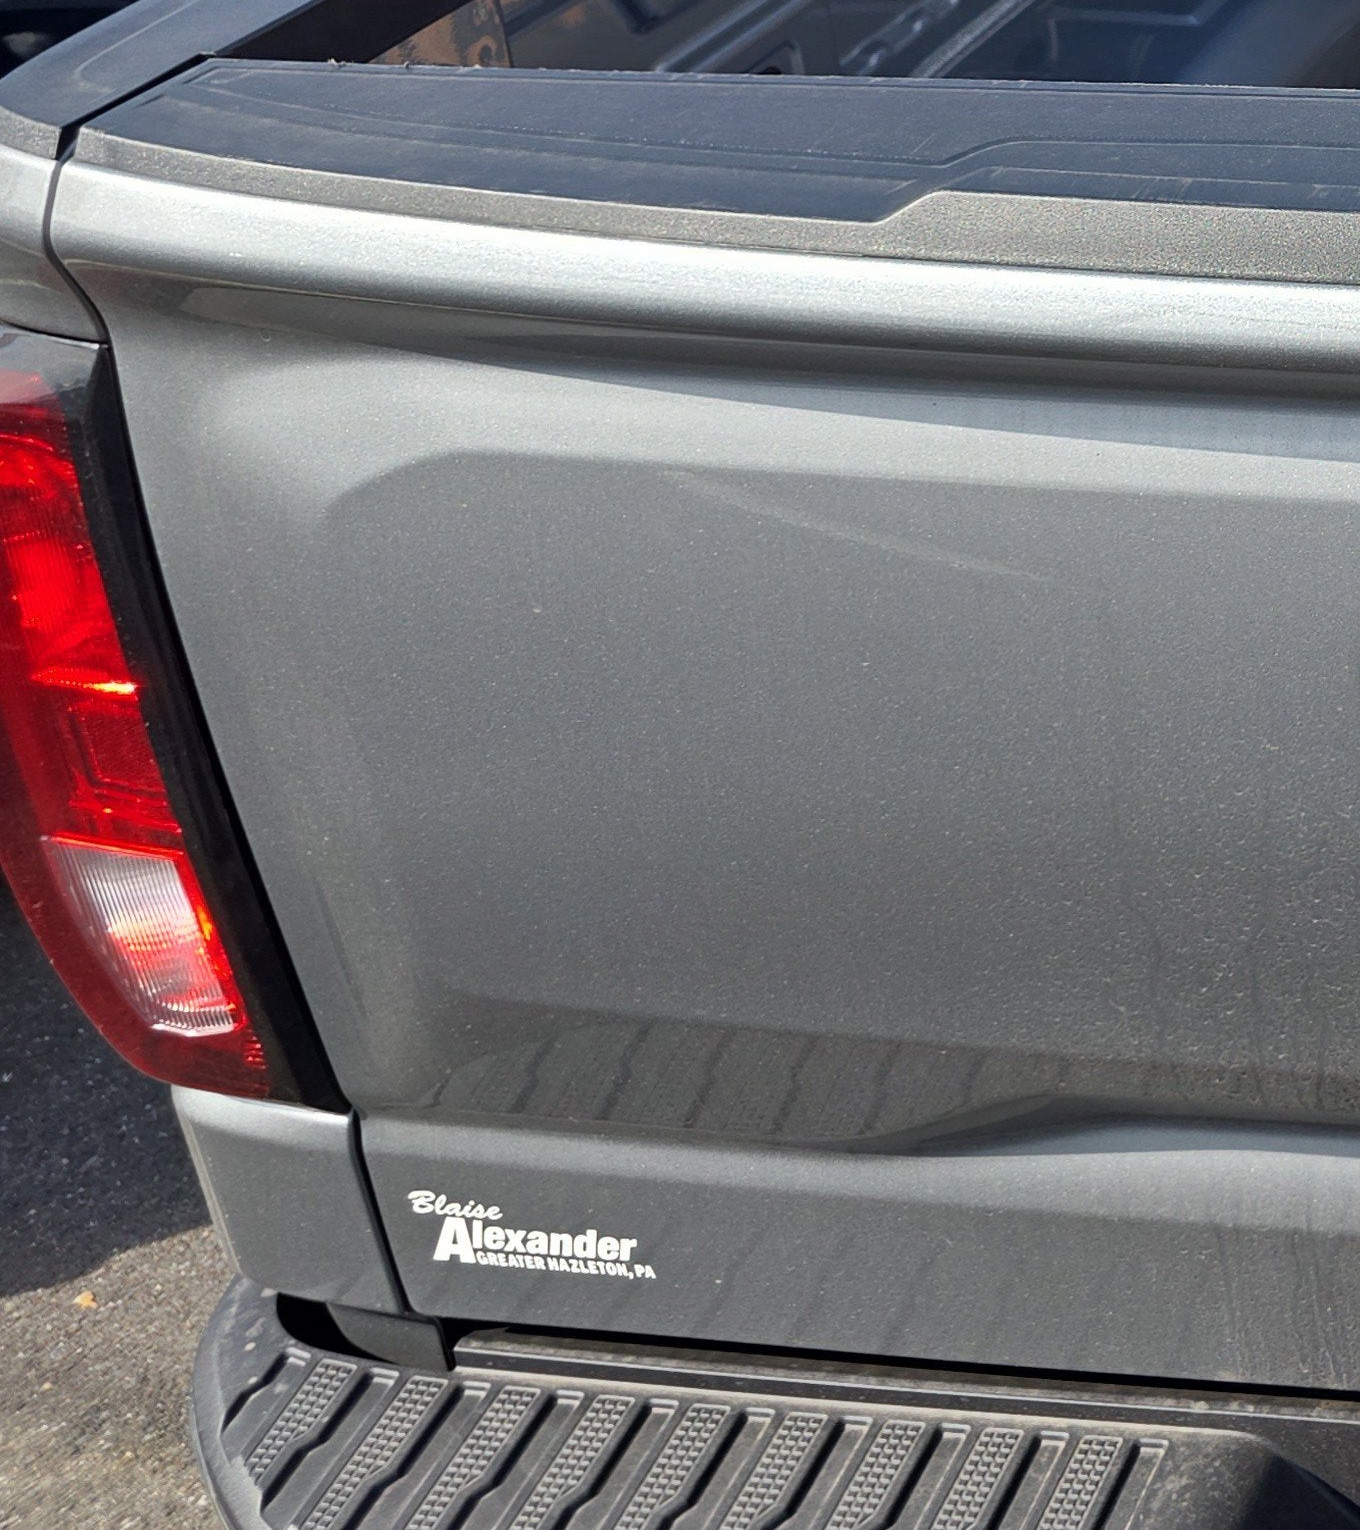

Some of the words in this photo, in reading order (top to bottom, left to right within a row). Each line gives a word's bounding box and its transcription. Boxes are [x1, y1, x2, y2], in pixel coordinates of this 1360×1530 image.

[407, 1189, 503, 1220] Blaise
[432, 1216, 638, 1265] Alexander
[475, 1250, 547, 1271] GREATER
[546, 1256, 635, 1280] HAZLETON,
[633, 1263, 657, 1280] PA
